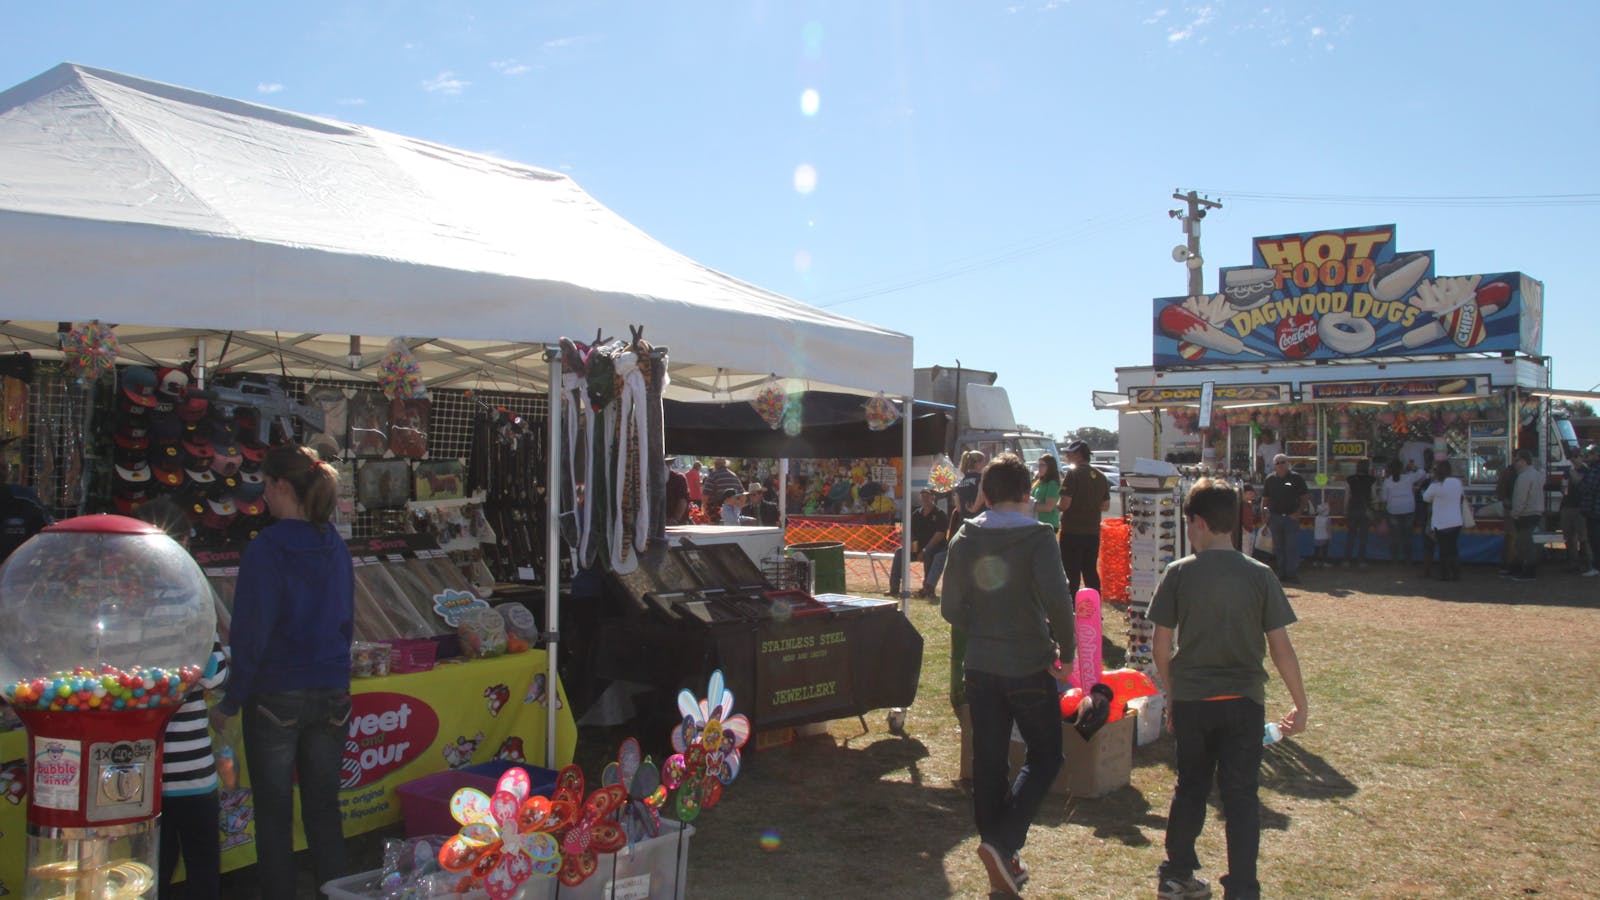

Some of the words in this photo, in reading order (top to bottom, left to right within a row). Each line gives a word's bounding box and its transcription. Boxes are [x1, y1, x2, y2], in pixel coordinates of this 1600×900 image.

[1257, 231, 1393, 270] HOT
[1272, 257, 1376, 290] FOOD
[1231, 291, 1348, 338] DAGWOOD
[1351, 292, 1421, 327] DUGS
[1458, 304, 1476, 343] CHIPS
[1160, 388, 1238, 399] DONTS
[761, 636, 815, 653] STAINLESS
[820, 631, 846, 645] STEEL
[772, 681, 836, 705] JEWELLERY
[361, 732, 385, 748] and
[37, 761, 78, 776] bubble
